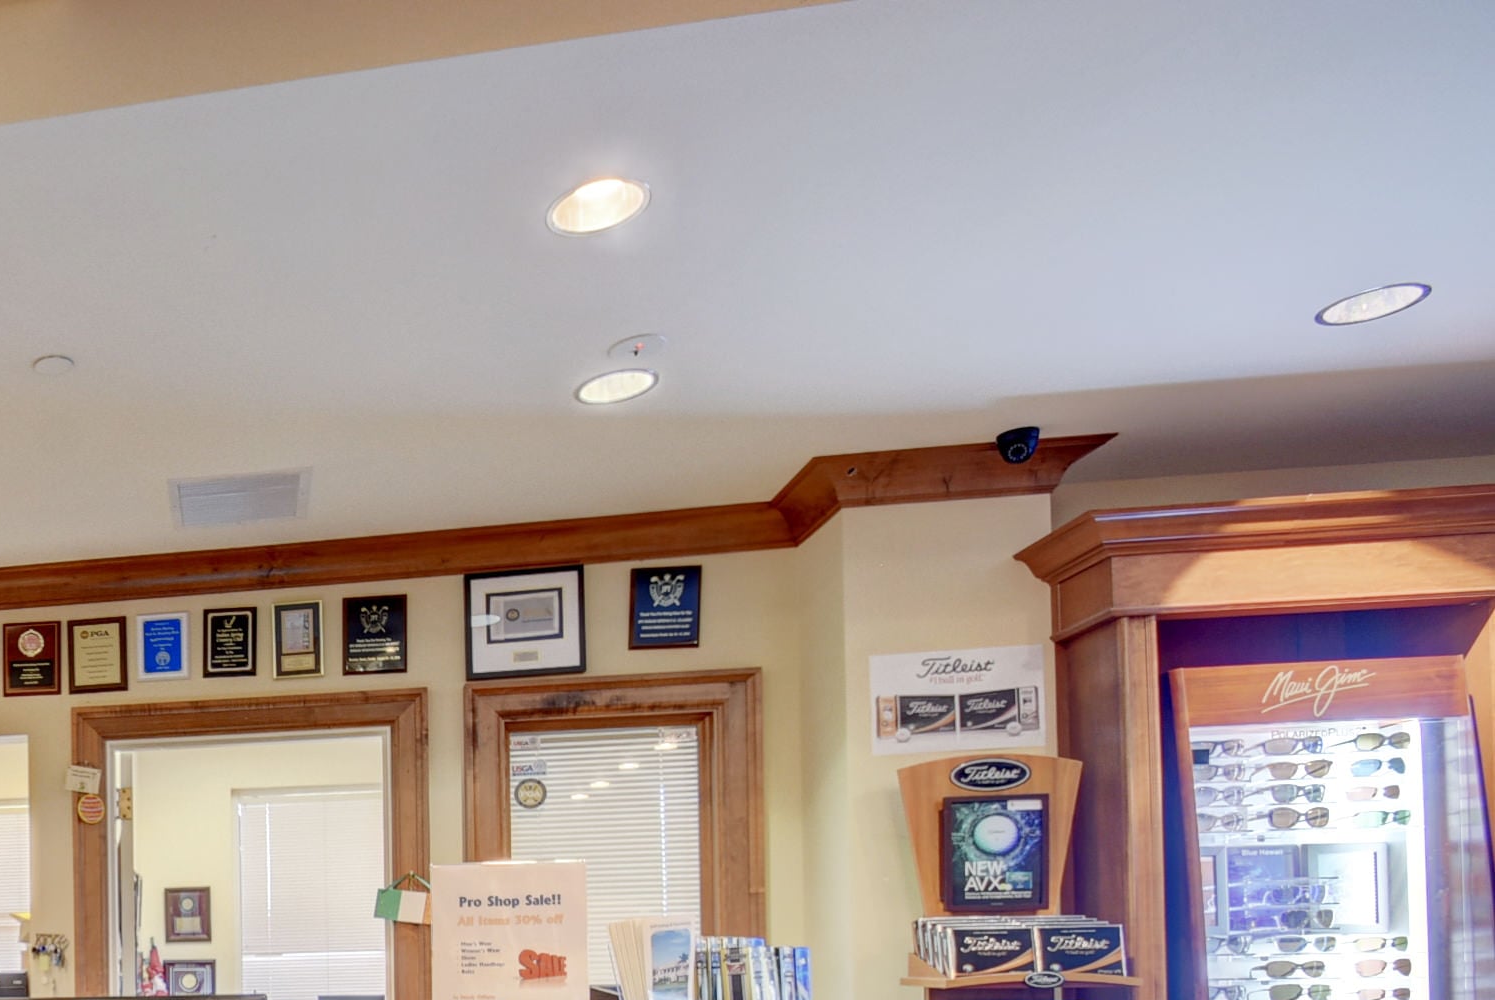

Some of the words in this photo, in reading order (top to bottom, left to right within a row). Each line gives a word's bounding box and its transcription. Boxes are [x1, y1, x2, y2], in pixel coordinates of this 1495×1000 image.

[916, 656, 995, 679] Titleist
[1262, 671, 1312, 703] Maui
[1313, 665, 1376, 717] Jim
[906, 701, 948, 715] Titleist
[964, 699, 1008, 712] Titleist
[961, 766, 1021, 783] Titleist
[964, 861, 1003, 876] NEW
[964, 876, 1001, 891] AVX
[459, 897, 482, 908] Pro
[487, 896, 520, 908] Shop
[525, 894, 561, 906] Sale!!
[457, 915, 474, 927] All
[479, 915, 510, 926] Items
[546, 914, 564, 924] off
[960, 935, 1022, 954] Titleist
[1047, 934, 1110, 952] Titleist
[518, 949, 567, 980] SALE
